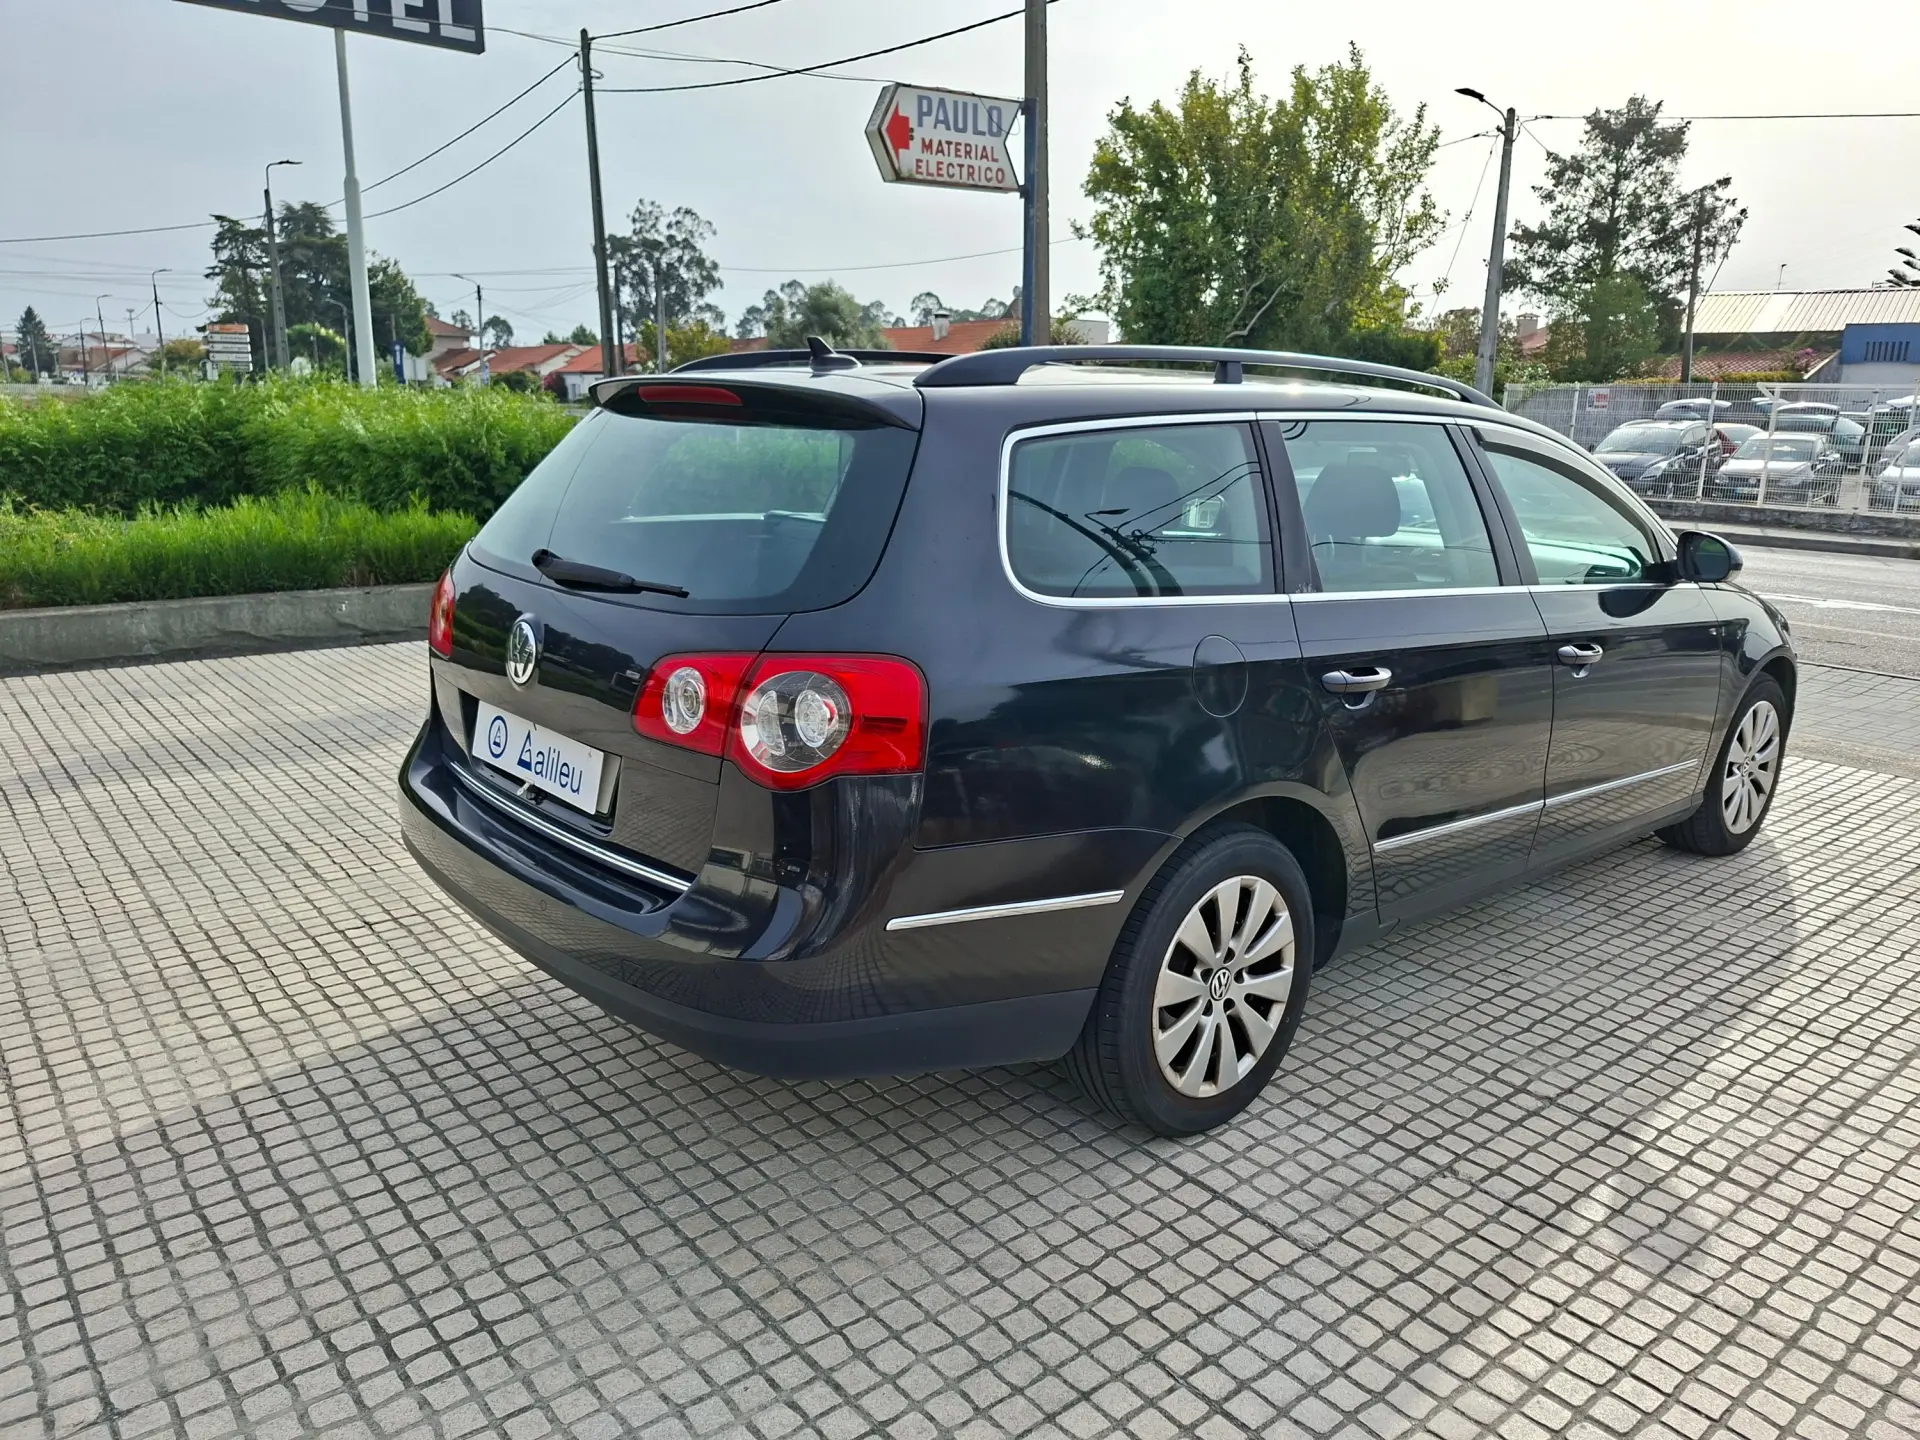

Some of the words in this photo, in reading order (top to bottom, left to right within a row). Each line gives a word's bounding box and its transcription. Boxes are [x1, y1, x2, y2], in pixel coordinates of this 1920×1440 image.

[917, 95, 1003, 137] PAULO
[921, 138, 999, 163] MATERIAL
[915, 158, 1005, 184] ELECTRICO
[517, 729, 583, 795] Galileu
